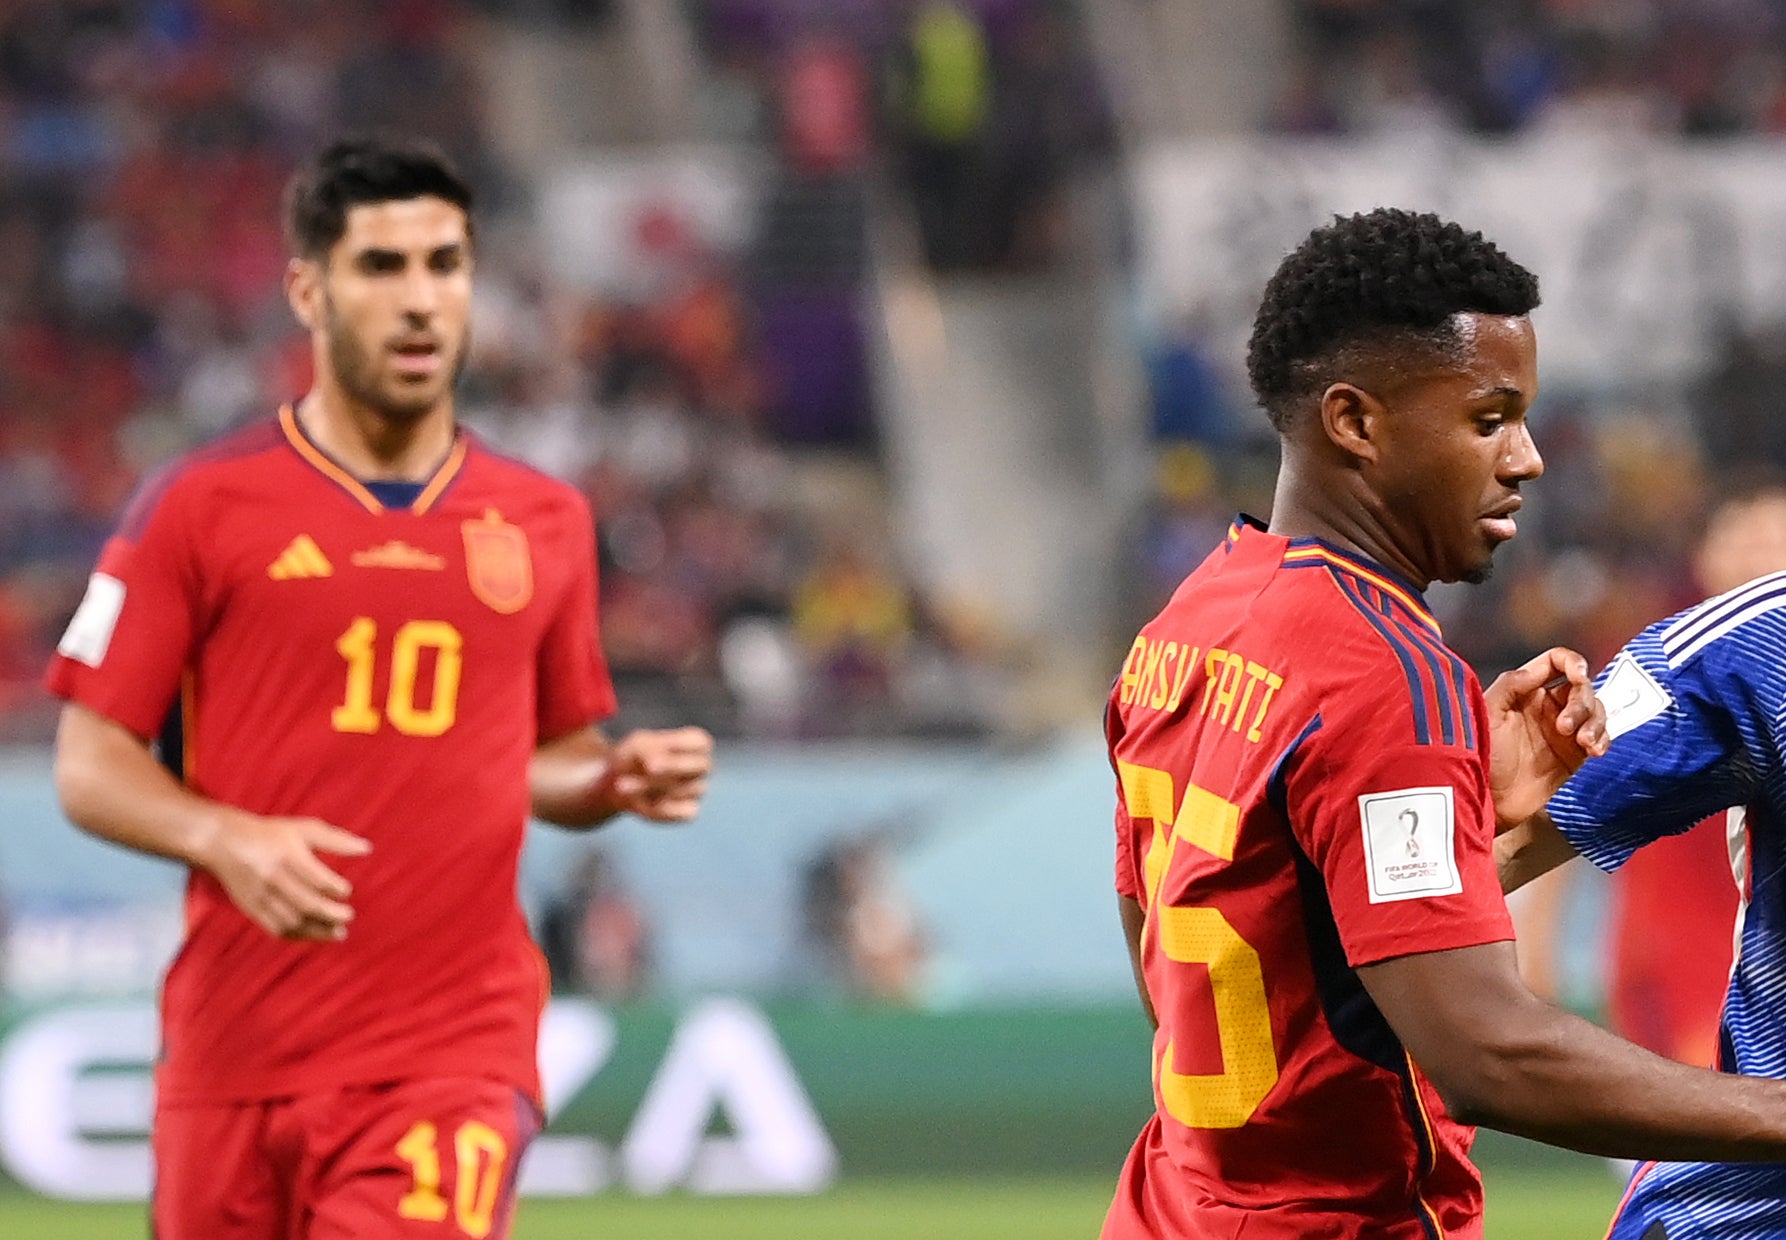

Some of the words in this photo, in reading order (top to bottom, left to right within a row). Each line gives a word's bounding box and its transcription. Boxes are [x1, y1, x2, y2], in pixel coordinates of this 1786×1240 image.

[331, 616, 462, 738] 10
[1121, 635, 1199, 713] ANSU
[1201, 648, 1283, 743] FATI
[1401, 862, 1427, 871] WORLD
[395, 1120, 507, 1240] 10
